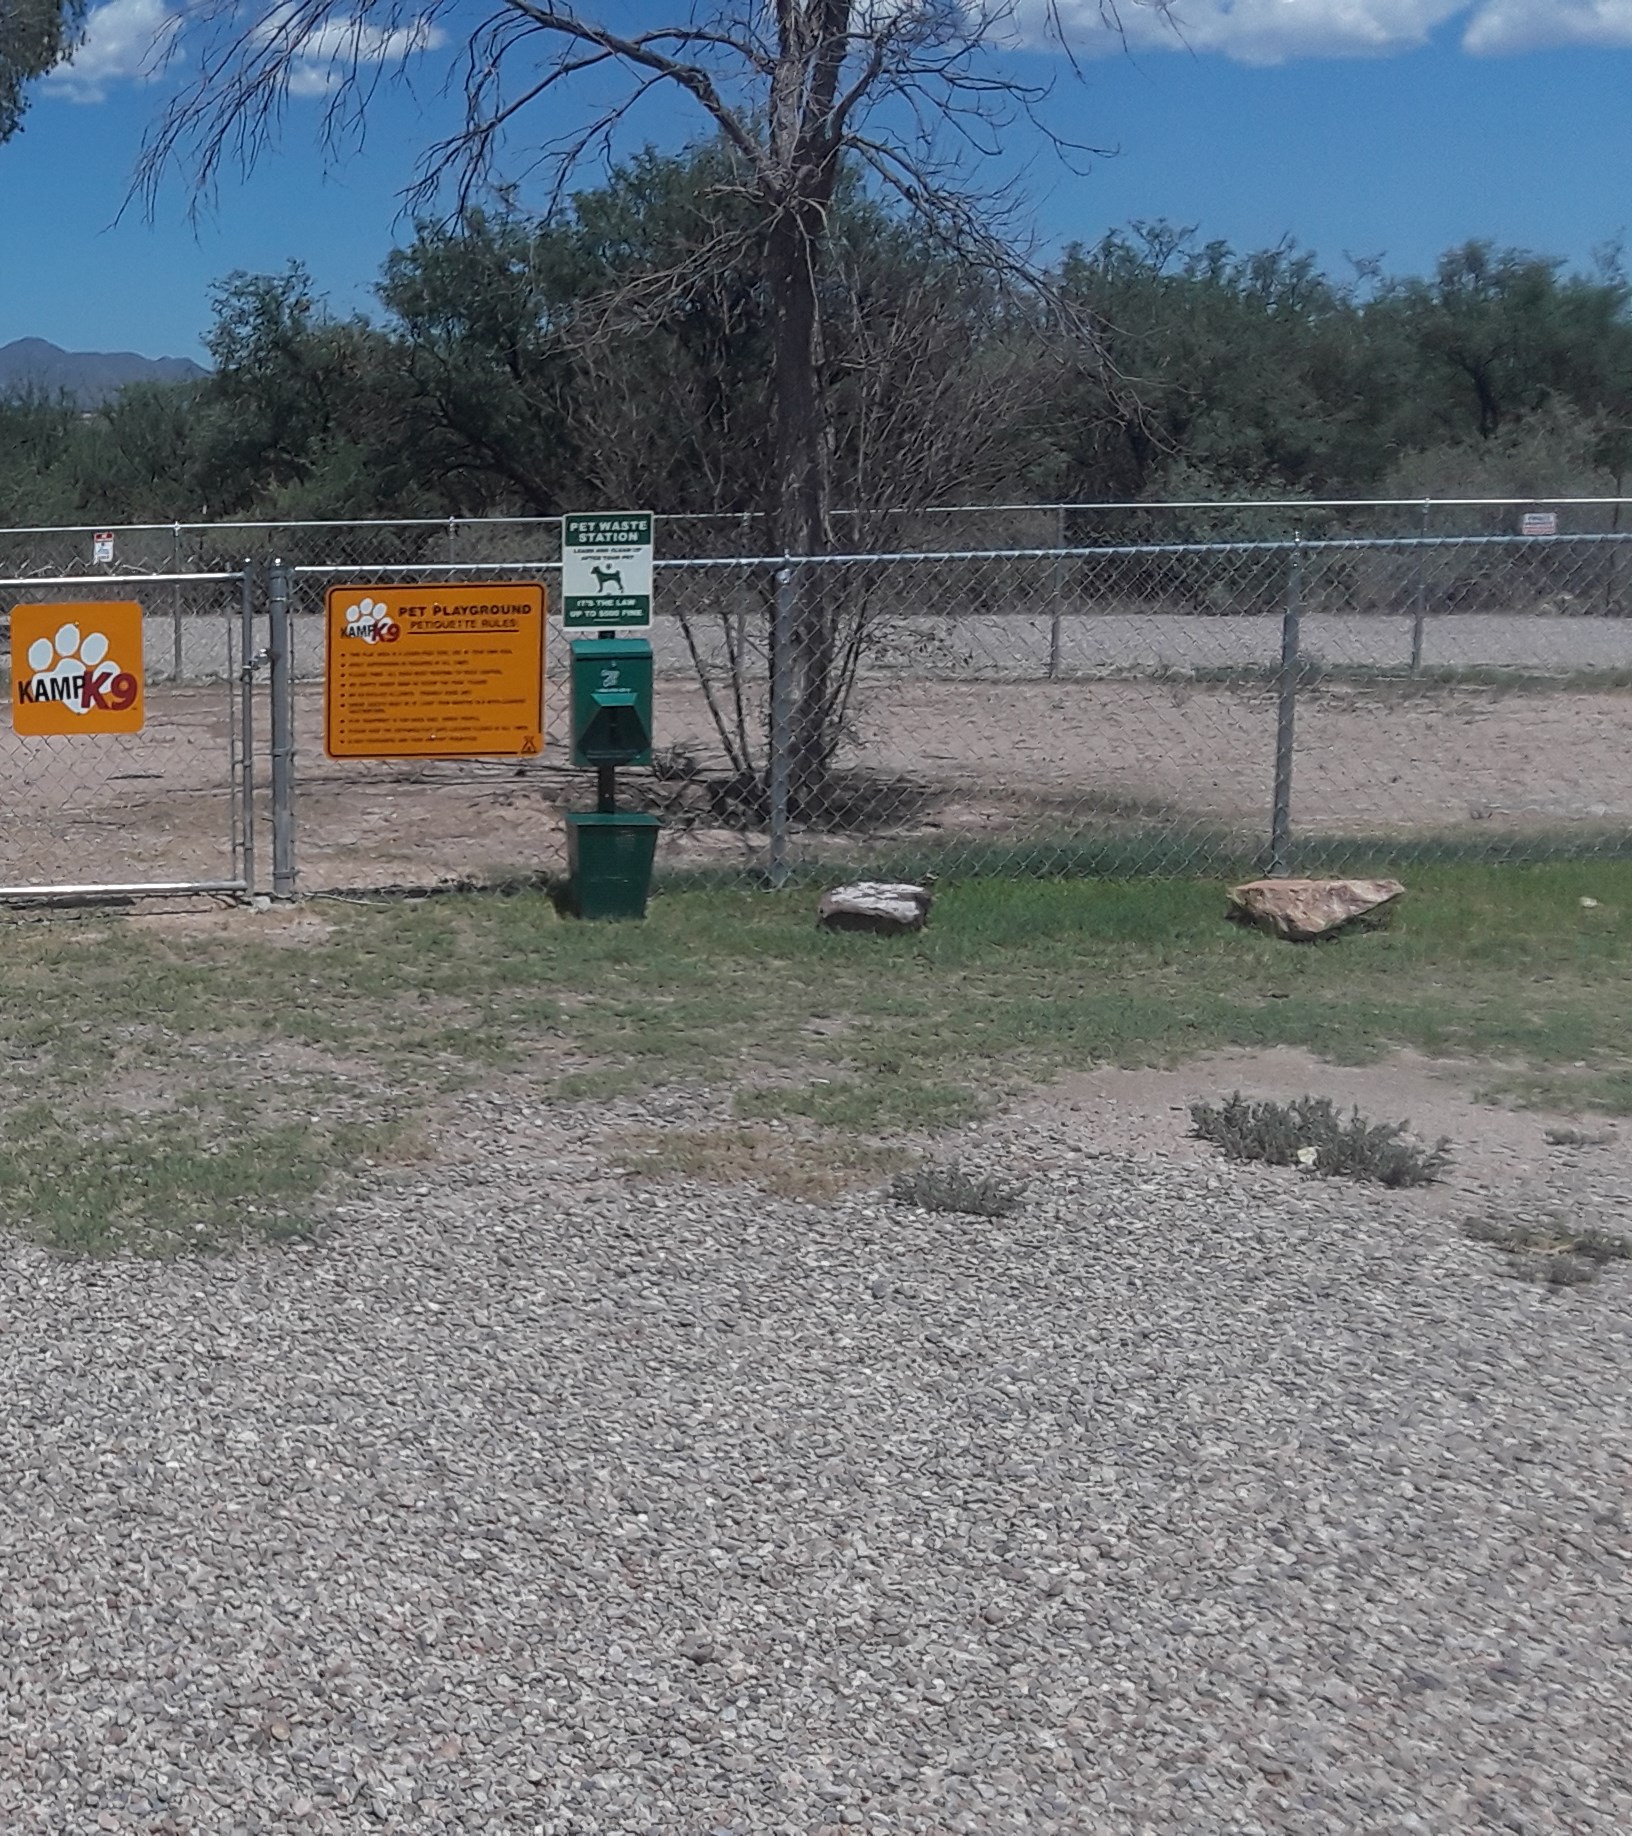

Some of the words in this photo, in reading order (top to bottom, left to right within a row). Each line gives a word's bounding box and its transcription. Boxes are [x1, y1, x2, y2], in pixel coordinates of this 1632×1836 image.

[569, 522, 595, 532] PET
[599, 520, 648, 531] WASTE
[578, 531, 639, 543] STATION
[596, 599, 614, 607] THE
[398, 606, 427, 617] PET
[433, 604, 532, 616] PLAYGROUND
